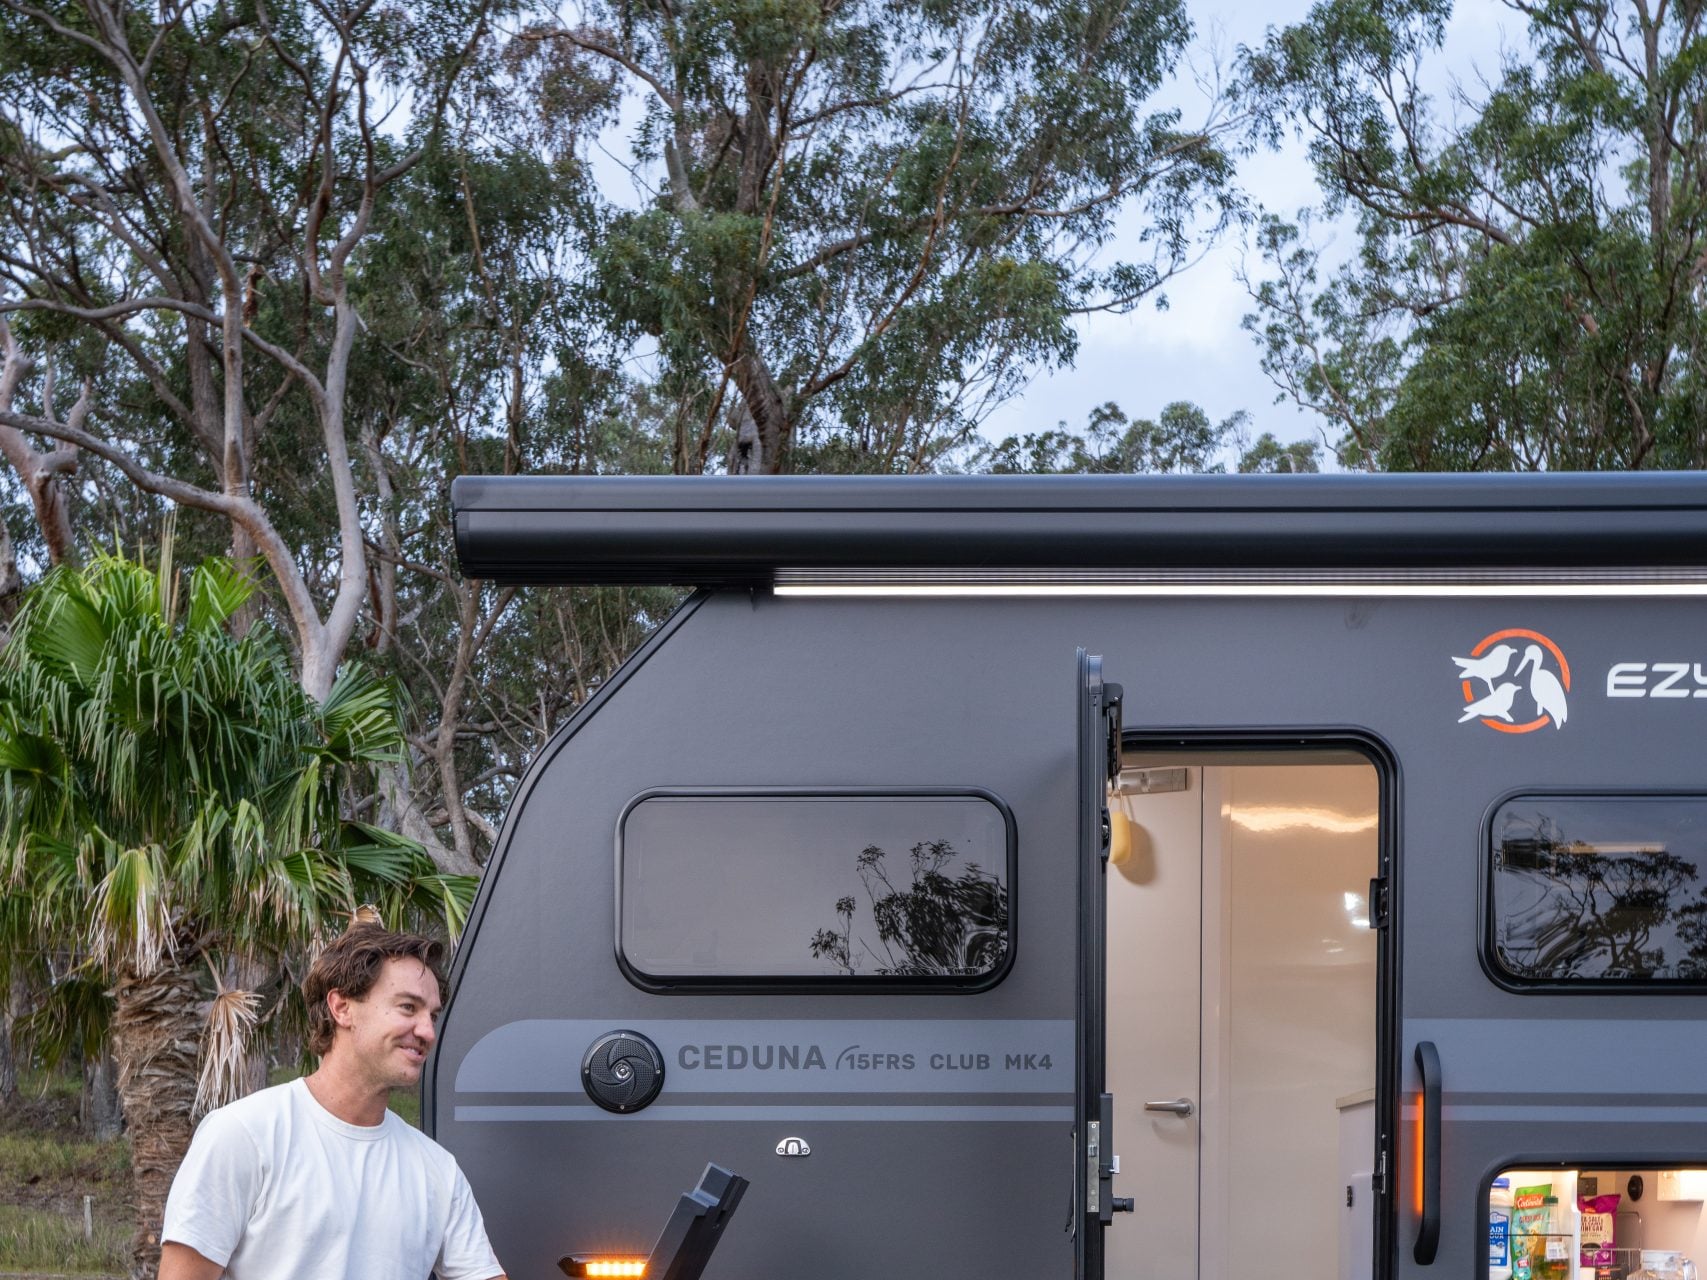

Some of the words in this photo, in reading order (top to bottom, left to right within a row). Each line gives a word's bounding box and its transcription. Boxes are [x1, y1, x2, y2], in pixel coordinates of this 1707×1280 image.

[678, 1044, 826, 1070] CEDUNA
[845, 1053, 915, 1070] 15FRS
[929, 1053, 990, 1070] CLUB
[1004, 1053, 1053, 1071] MK4
